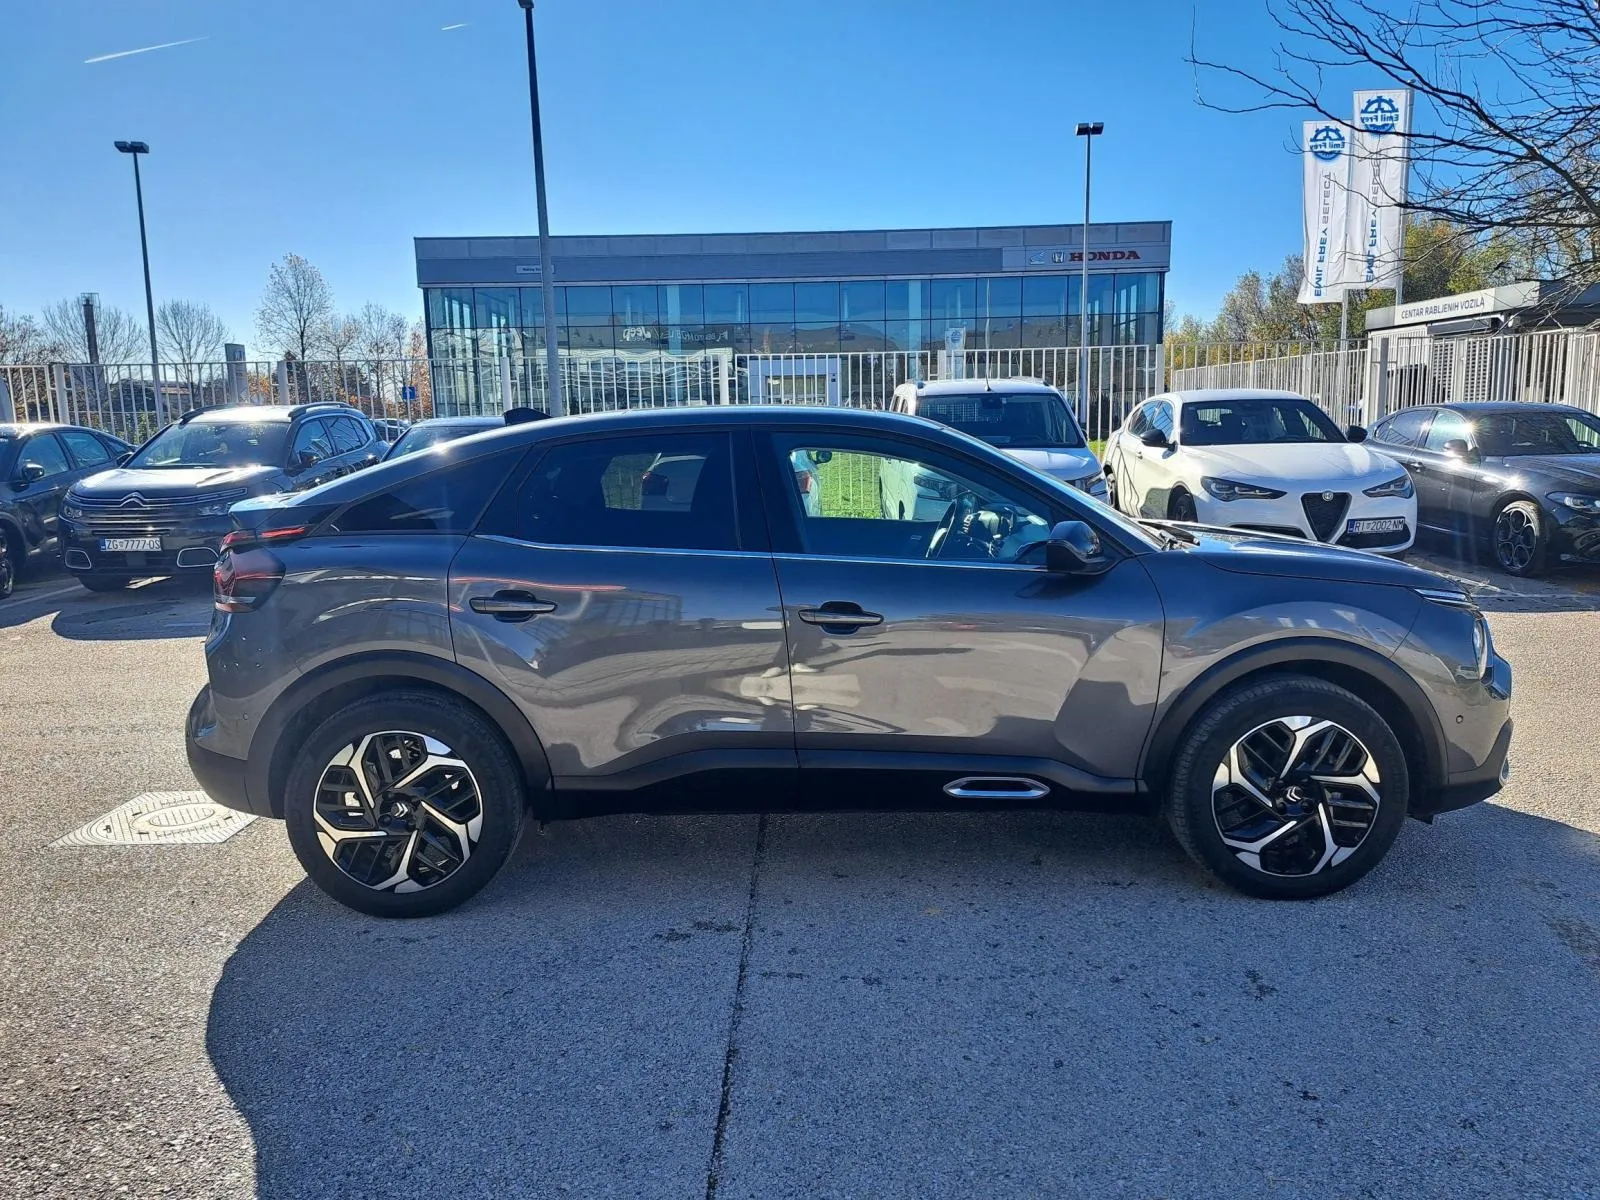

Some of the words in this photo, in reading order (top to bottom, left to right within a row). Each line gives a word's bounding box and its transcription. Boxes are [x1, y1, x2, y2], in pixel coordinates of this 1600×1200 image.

[1069, 251, 1141, 262] HONDA
[1401, 306, 1424, 319] CENTAR
[1425, 302, 1459, 315] RABLJENIH
[1460, 296, 1485, 310] VOZILA
[106, 539, 118, 549] ZG
